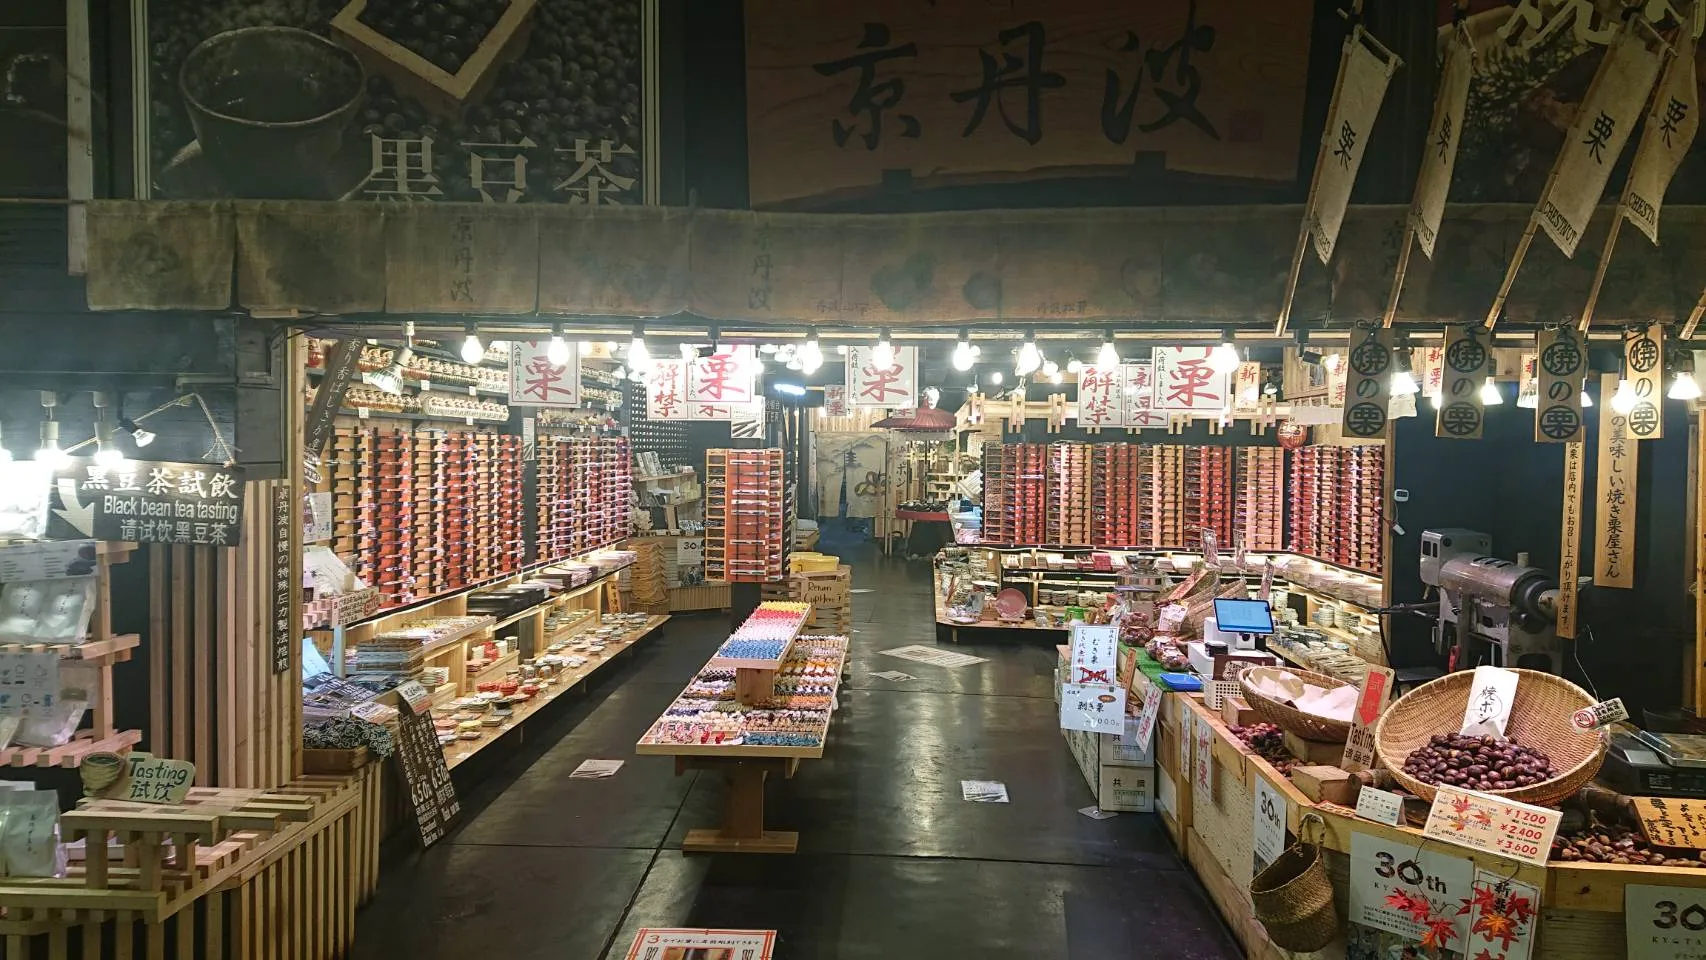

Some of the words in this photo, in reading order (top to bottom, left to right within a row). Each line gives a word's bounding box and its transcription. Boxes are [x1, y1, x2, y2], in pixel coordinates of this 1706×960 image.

[812, 0, 1219, 149] 京丹波
[1437, 112, 1452, 165] 栗
[1582, 110, 1616, 164] 栗
[1660, 95, 1689, 148] 栗
[364, 133, 636, 205] 黒豆茶
[1334, 120, 1356, 171] 栗
[1543, 201, 1578, 245] CHESTNUT
[1082, 367, 1116, 424] 解禁
[103, 495, 137, 514] Black
[140, 496, 171, 517] bean
[175, 498, 194, 519] tea
[197, 500, 237, 524] tasting
[1350, 724, 1375, 753] Tasting
[129, 757, 188, 785] Tasting
[130, 781, 176, 801] 试饮
[1261, 791, 1280, 830] 30th
[1374, 851, 1447, 894] 30th
